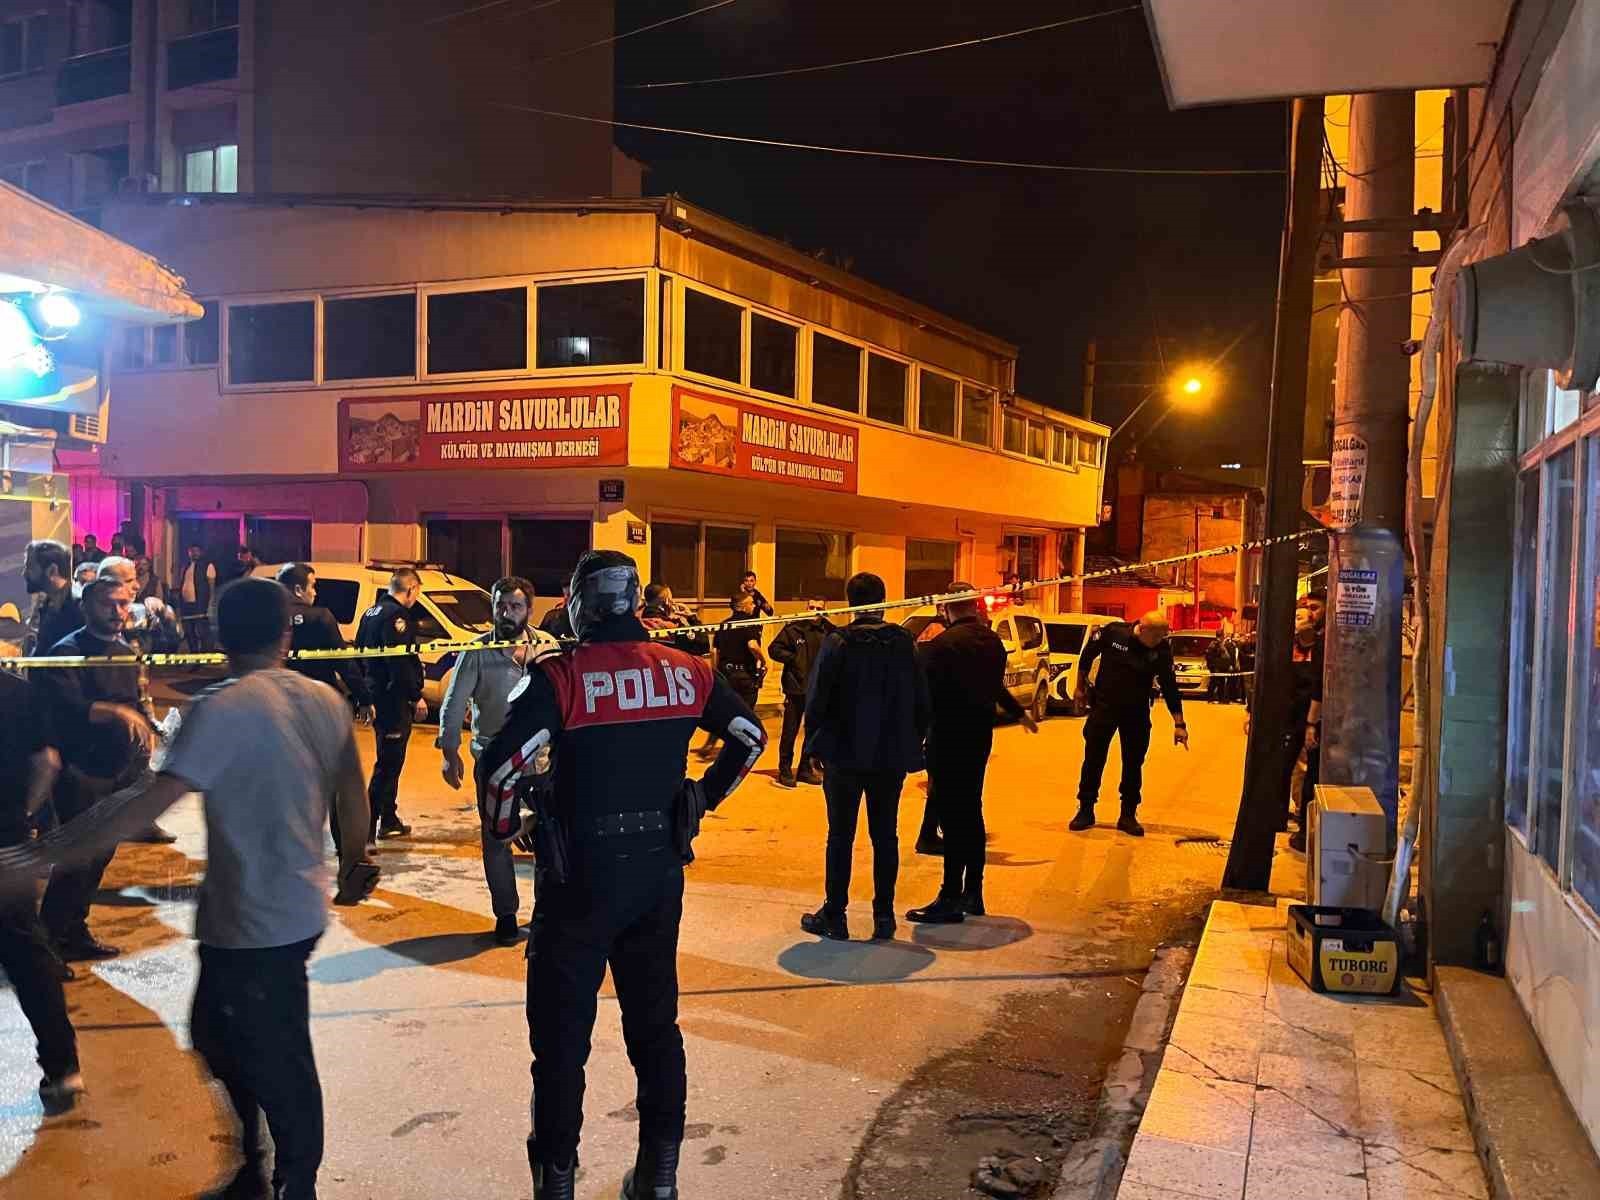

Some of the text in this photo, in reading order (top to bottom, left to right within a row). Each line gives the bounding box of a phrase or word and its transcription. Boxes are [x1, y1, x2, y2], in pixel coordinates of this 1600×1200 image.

[499, 396, 620, 431] SAVURLULAR
[441, 437, 599, 460] KÜLTÜR VE DAYANIŞMA DERNEĞİ
[789, 423, 853, 462] SAVURLULAR
[583, 659, 695, 713] POLİS
[1328, 958, 1388, 973] TUBORG
